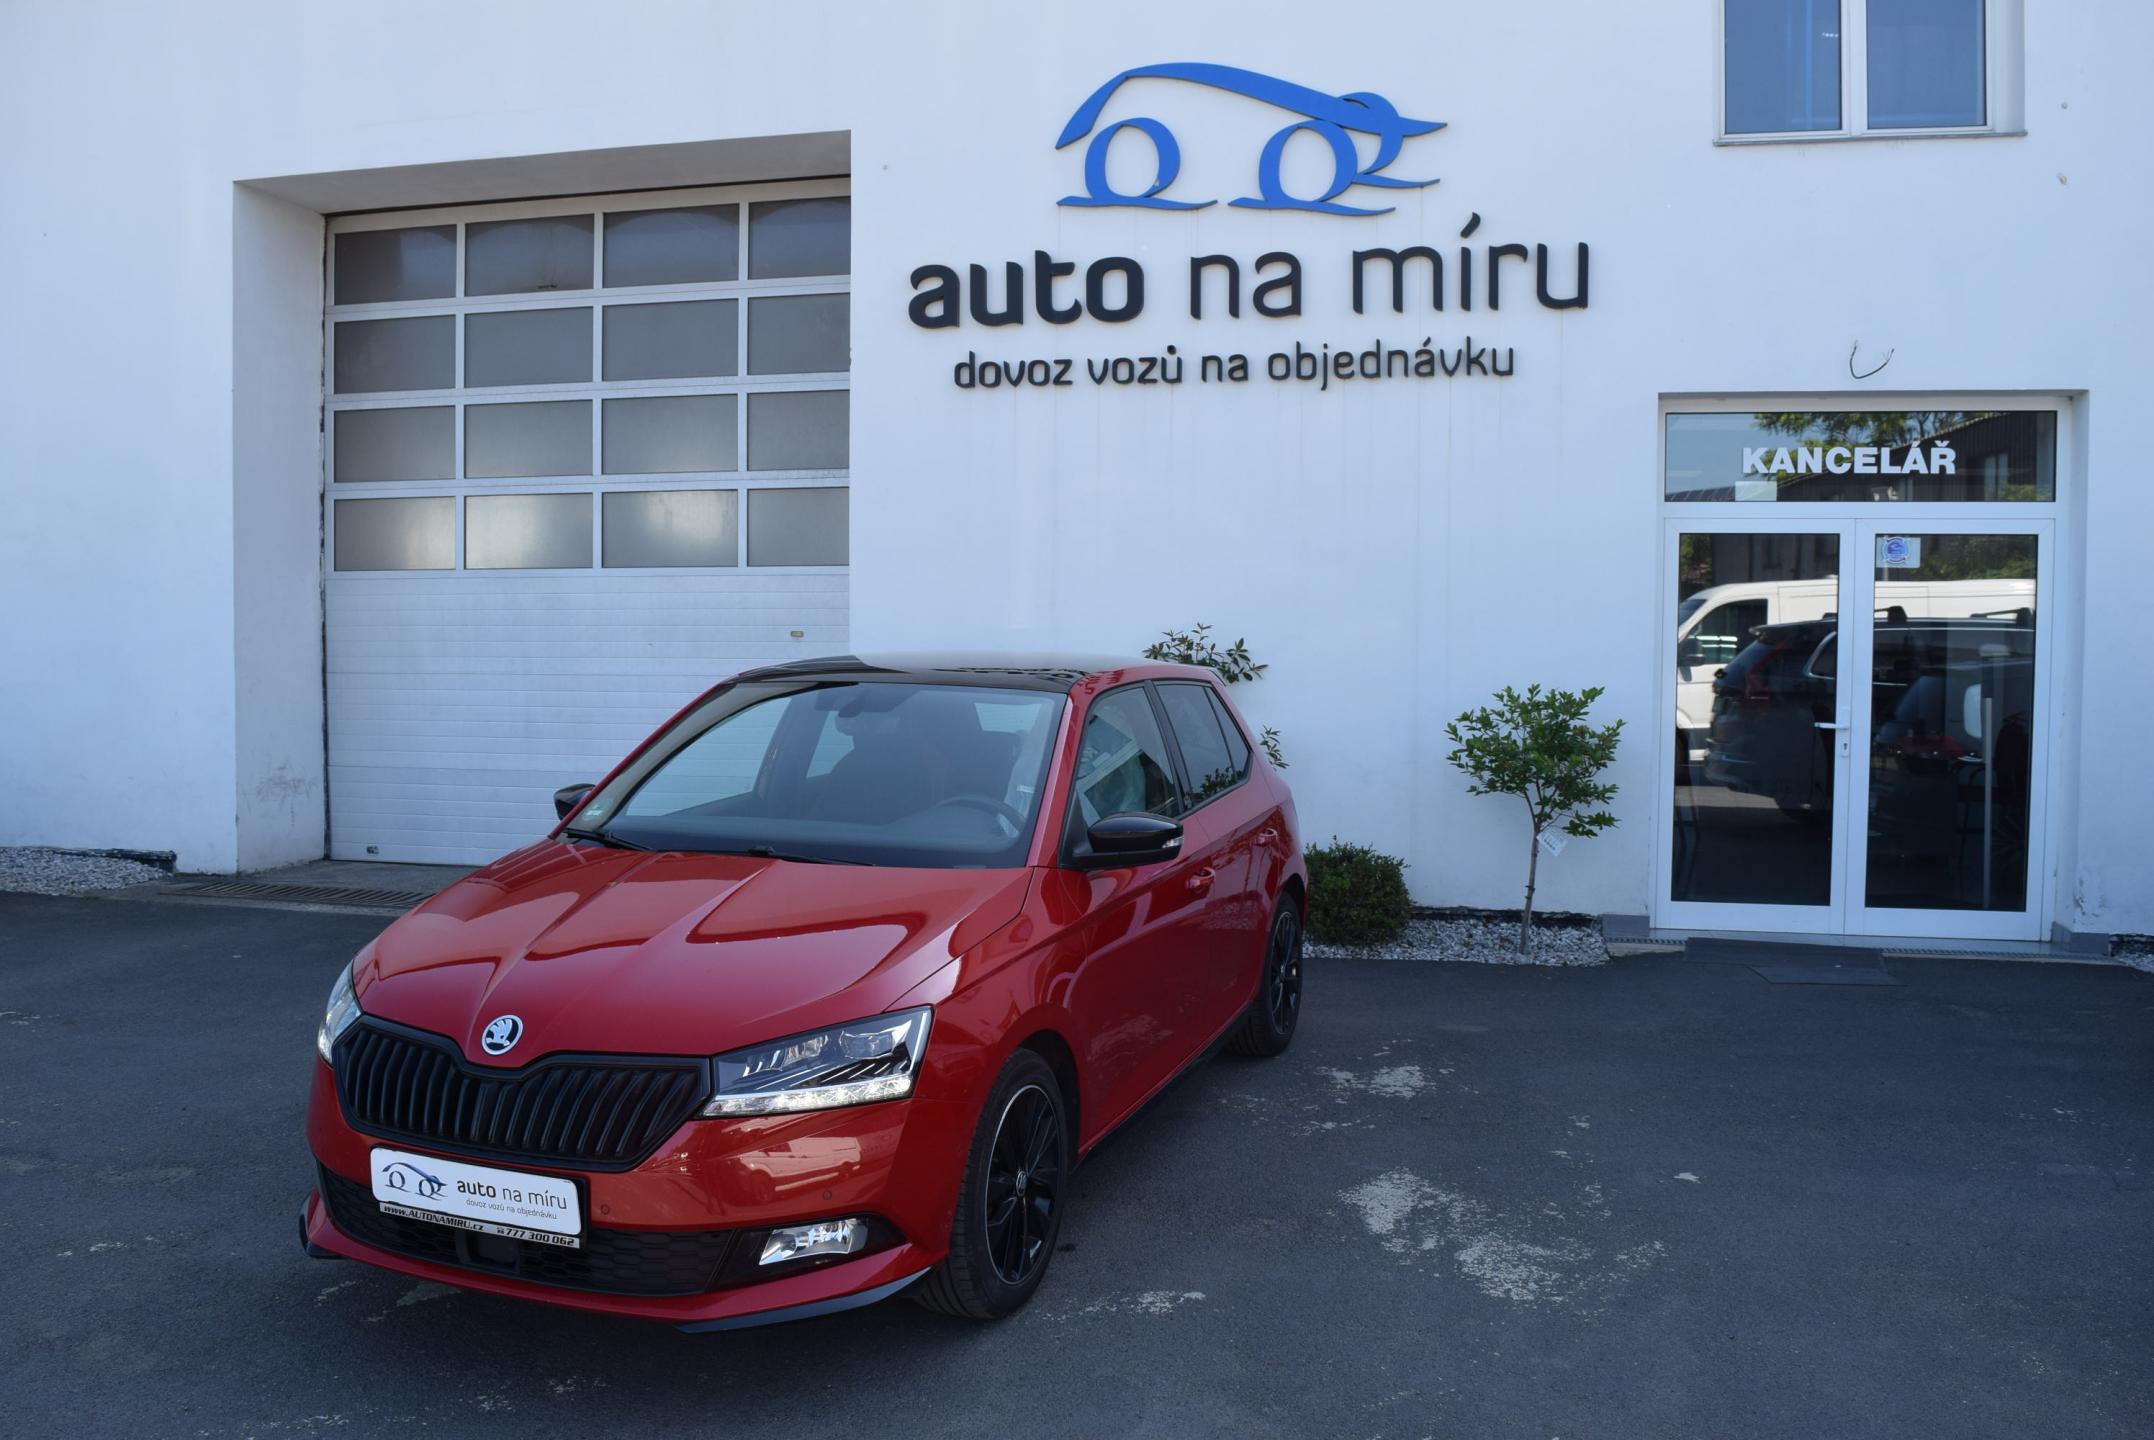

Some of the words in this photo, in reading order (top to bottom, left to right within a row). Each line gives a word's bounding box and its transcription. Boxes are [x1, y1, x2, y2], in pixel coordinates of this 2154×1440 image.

[909, 250, 1144, 329] auto
[1191, 252, 1301, 320] na
[1353, 212, 1589, 314] míru
[954, 351, 1073, 389] dovoz
[1088, 345, 1182, 385] vozů
[1201, 354, 1248, 382] na
[1268, 336, 1513, 391] objednávku
[1742, 440, 1956, 475] KANCELÁŘ
[457, 1180, 496, 1198] auto
[503, 1187, 522, 1203] na
[528, 1190, 567, 1209] míru
[466, 1198, 486, 1208] dovoz
[506, 1227, 525, 1238] 777
[528, 1232, 549, 1243] 300
[552, 1235, 575, 1246] 062
